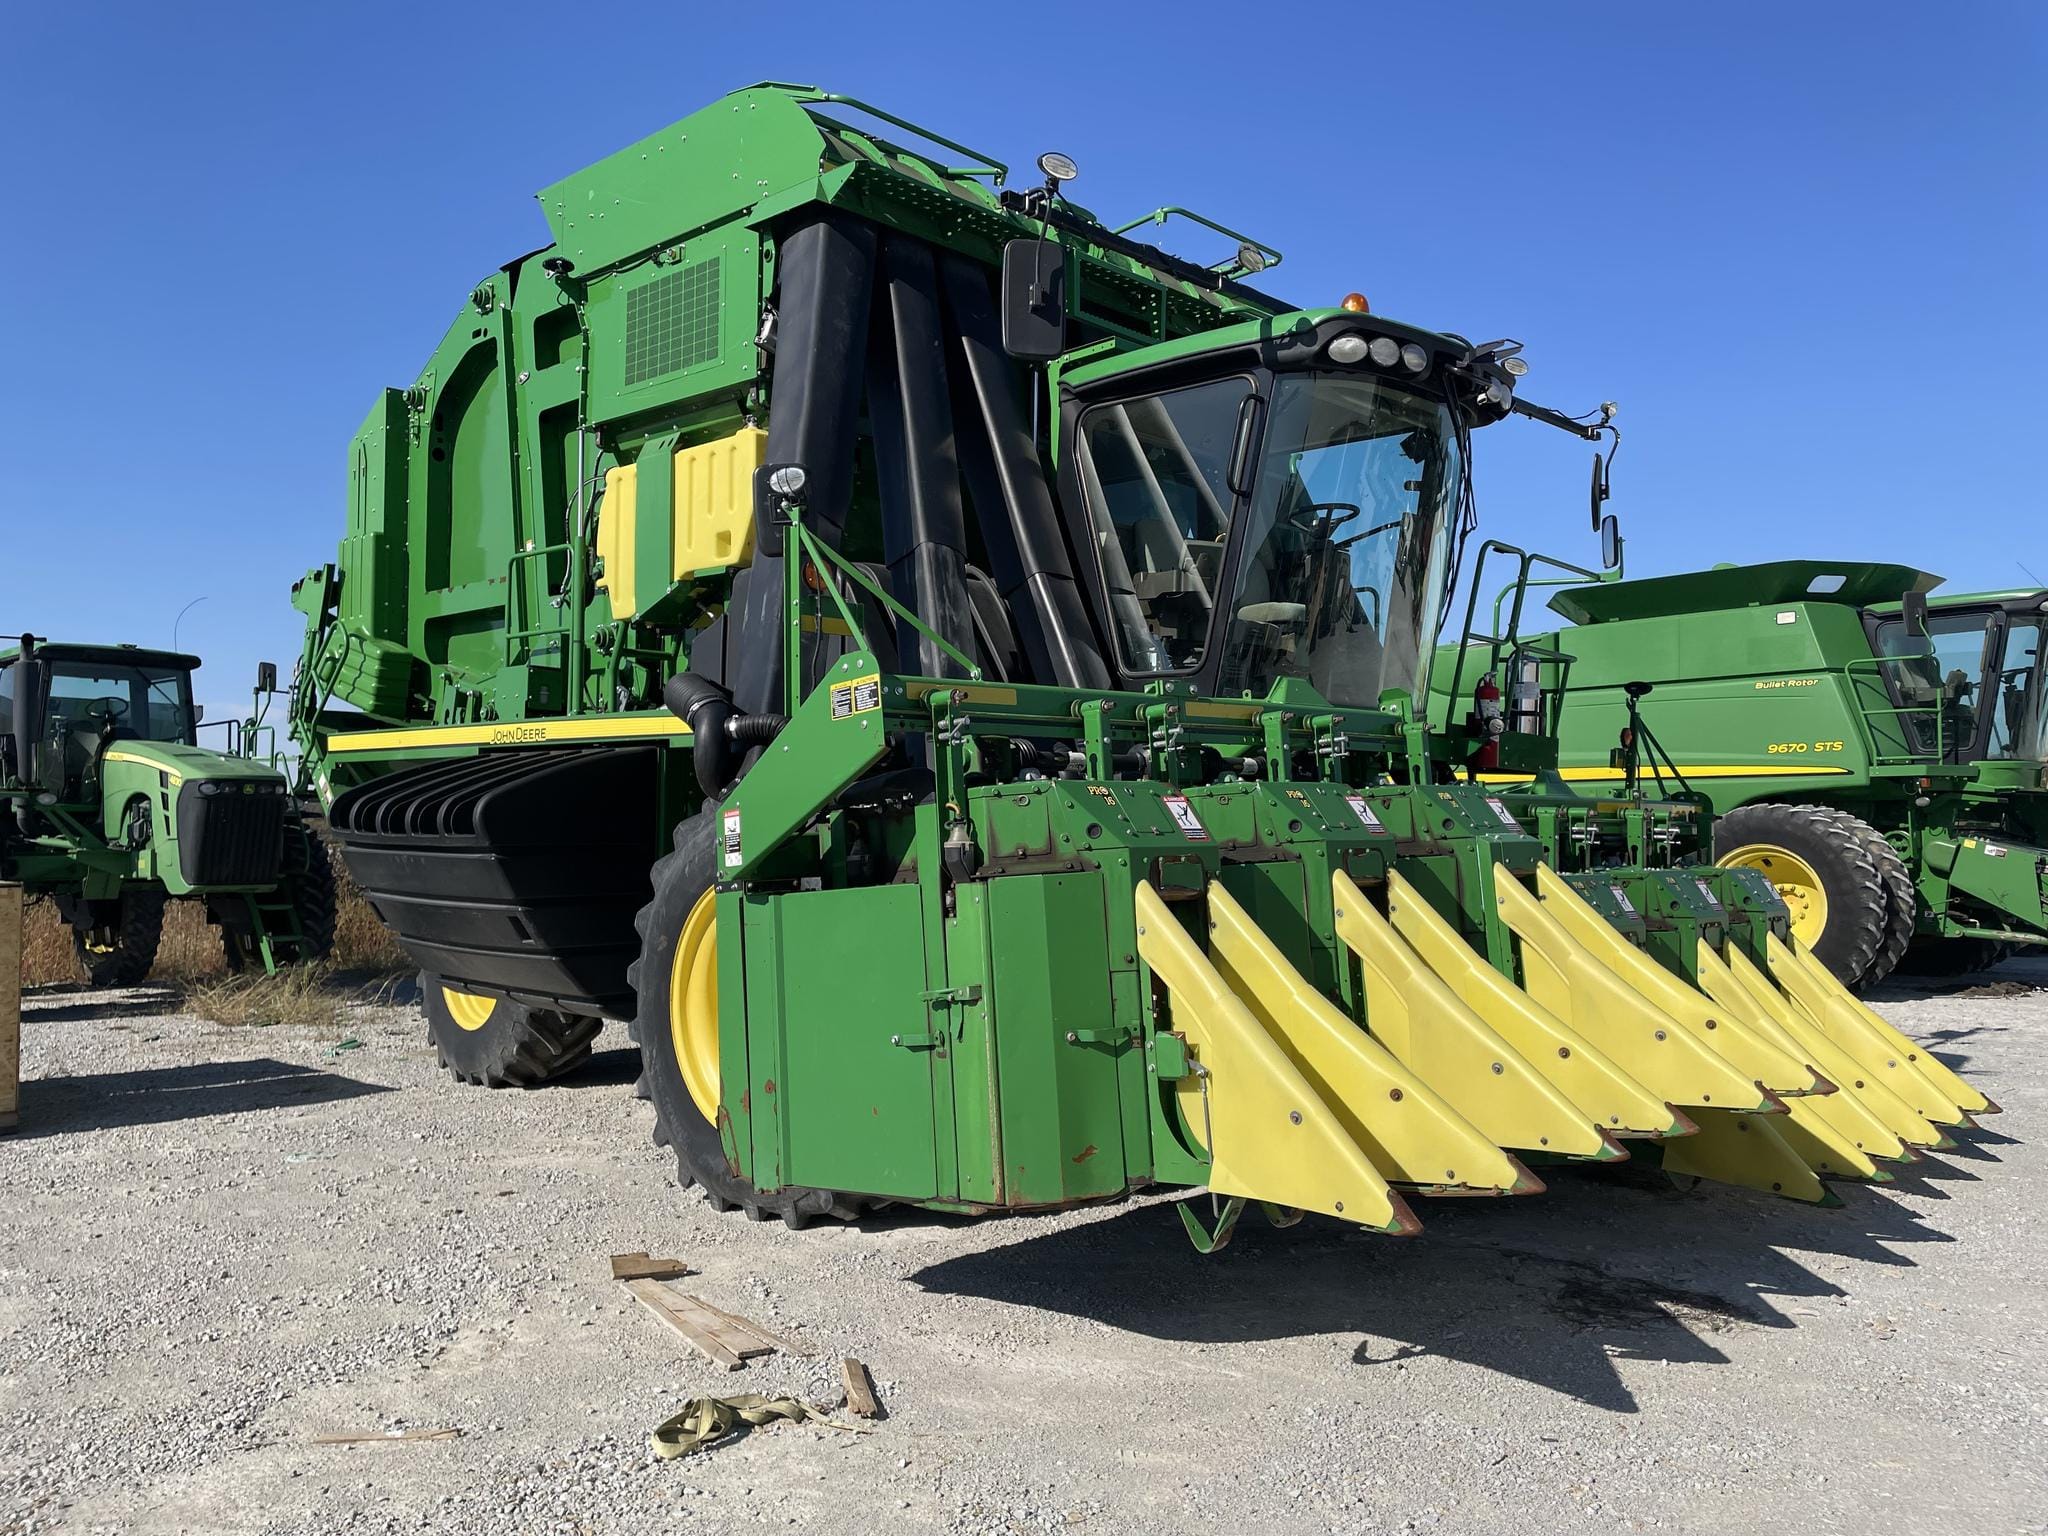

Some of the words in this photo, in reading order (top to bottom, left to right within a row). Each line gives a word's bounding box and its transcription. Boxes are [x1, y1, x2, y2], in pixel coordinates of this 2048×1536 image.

[1755, 682, 1786, 690] Bullet
[1787, 679, 1819, 688] Rotor
[1767, 743, 1808, 754] 9670
[1814, 741, 1844, 752] STS
